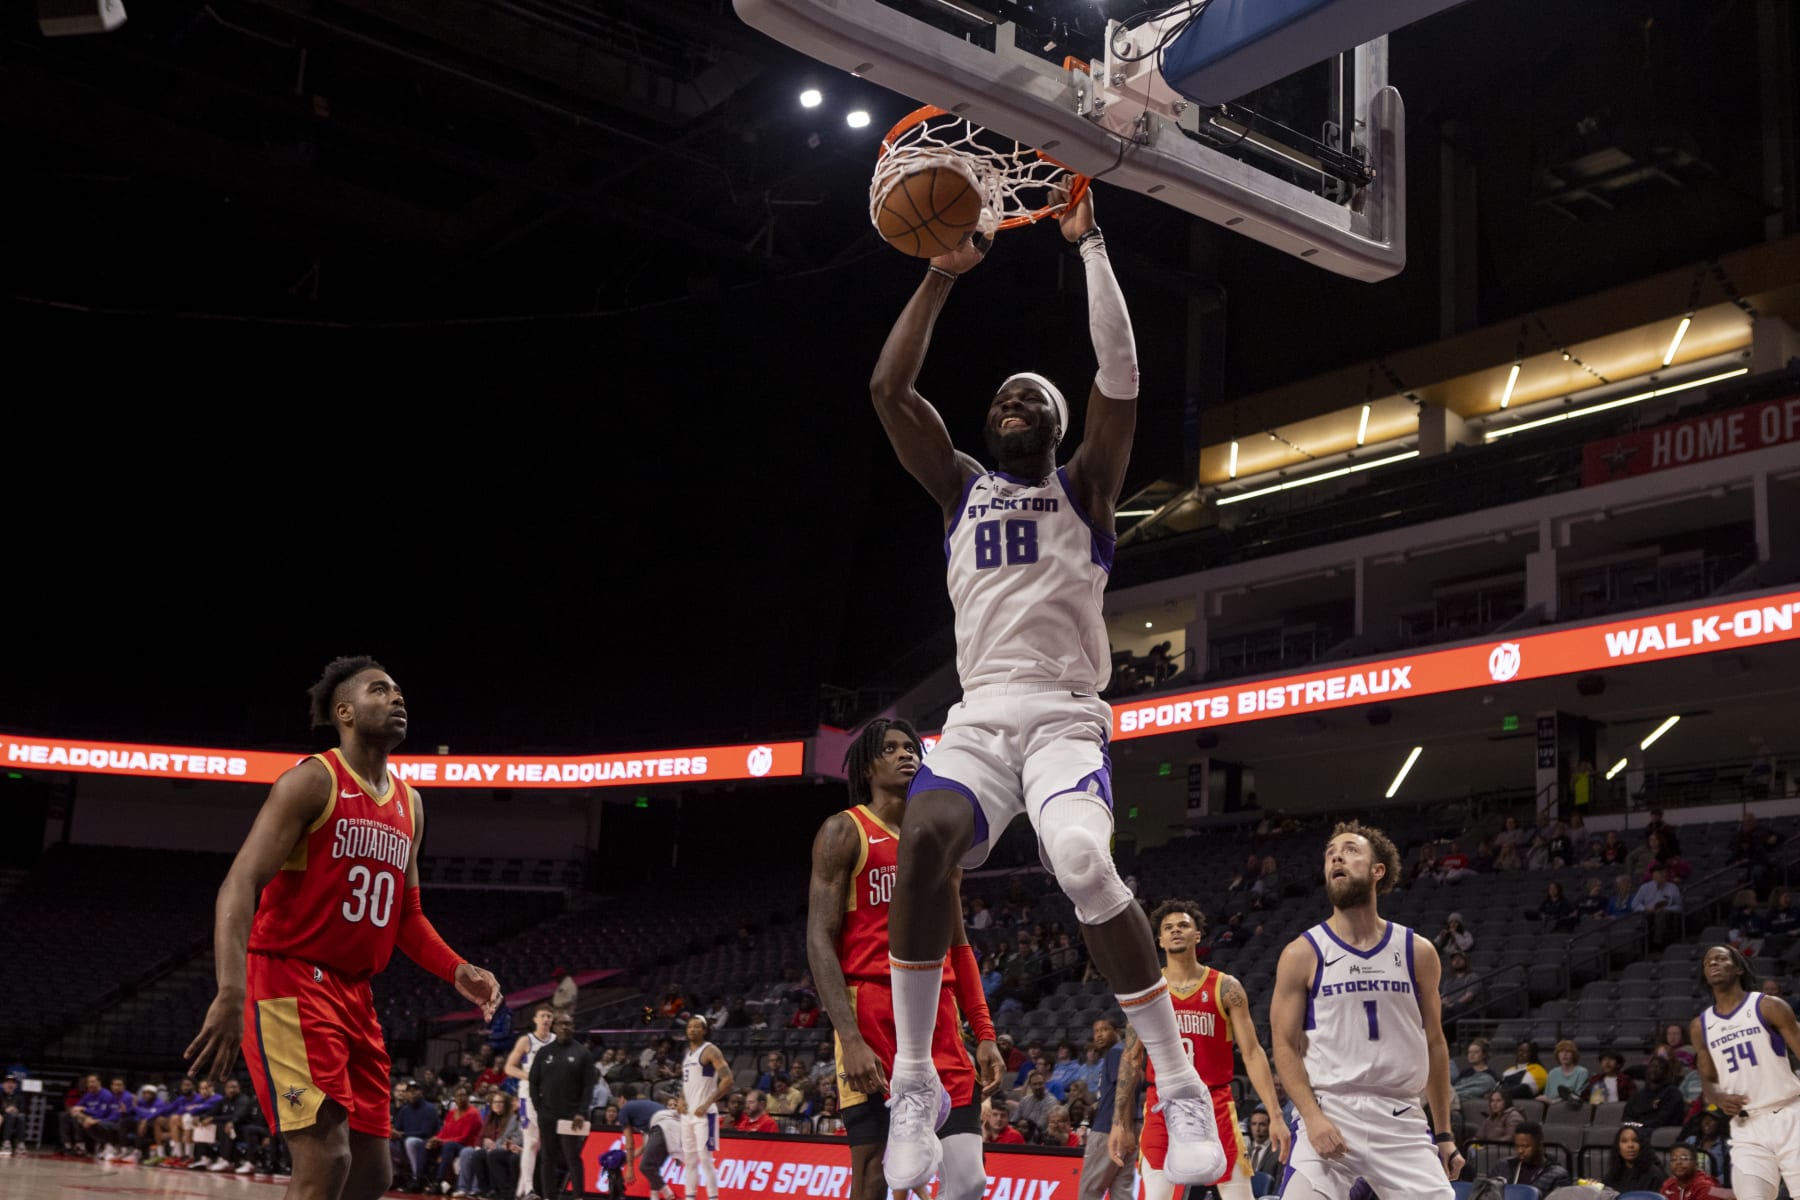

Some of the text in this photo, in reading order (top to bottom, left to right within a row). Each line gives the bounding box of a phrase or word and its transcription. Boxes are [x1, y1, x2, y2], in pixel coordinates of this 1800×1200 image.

[1652, 401, 1800, 467] HOME OF
[968, 498, 1059, 519] STCKTON
[975, 519, 1039, 570] 88
[1120, 666, 1412, 732] SPORTS BISTREAUX
[8, 743, 247, 776] HEADQUARTERS
[445, 763, 501, 782] DAY
[507, 756, 708, 783] HEADQUARTERS
[349, 818, 407, 840] BIRMINGHAM
[332, 818, 411, 874] SQUADRON
[342, 865, 396, 928] 30
[1321, 980, 1411, 997] STOCKTON
[1175, 1012, 1216, 1037] ADRON
[1363, 1000, 1380, 1041] 1
[1710, 1026, 1761, 1049] STOCKTON
[1722, 1041, 1758, 1074] 34
